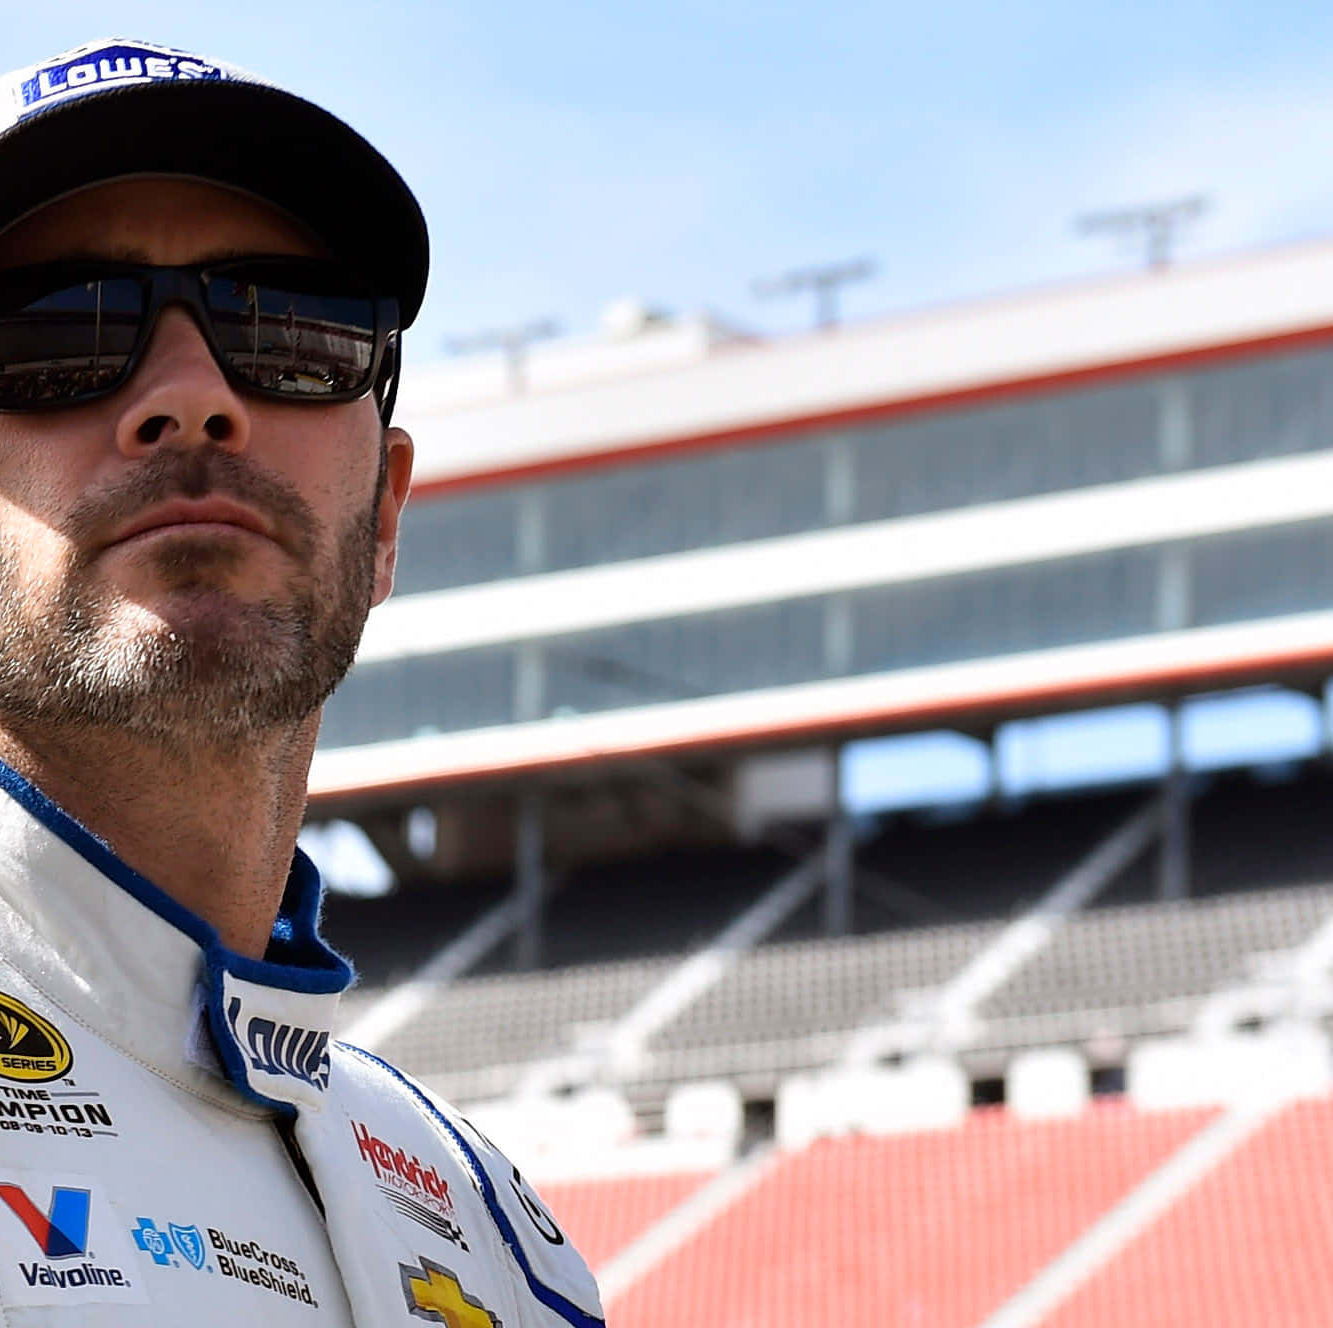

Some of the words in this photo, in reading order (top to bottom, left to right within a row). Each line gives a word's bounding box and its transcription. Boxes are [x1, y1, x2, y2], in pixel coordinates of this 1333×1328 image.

[38, 57, 206, 97] LOWE'S
[2, 1057, 57, 1071] SERIES
[350, 1120, 453, 1209] Hendrick
[207, 1228, 300, 1276] BlueCross
[19, 1263, 125, 1289] Valvoline
[216, 1254, 313, 1305] BlueShield
